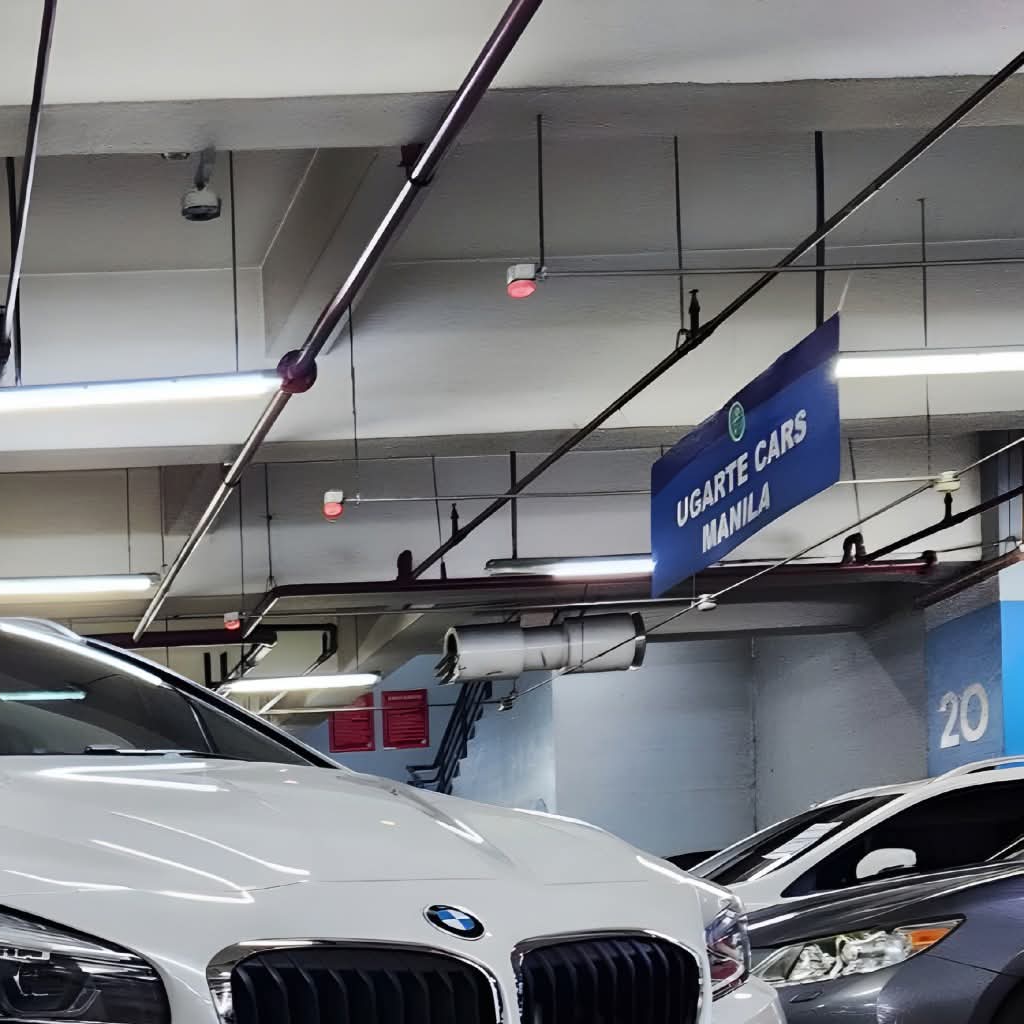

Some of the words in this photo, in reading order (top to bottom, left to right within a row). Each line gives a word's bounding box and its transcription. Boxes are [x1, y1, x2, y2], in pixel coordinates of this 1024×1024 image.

[676, 452, 748, 528] UGARTE
[754, 408, 807, 472] CARS
[702, 481, 771, 553] MANILA
[937, 683, 988, 749] 20
